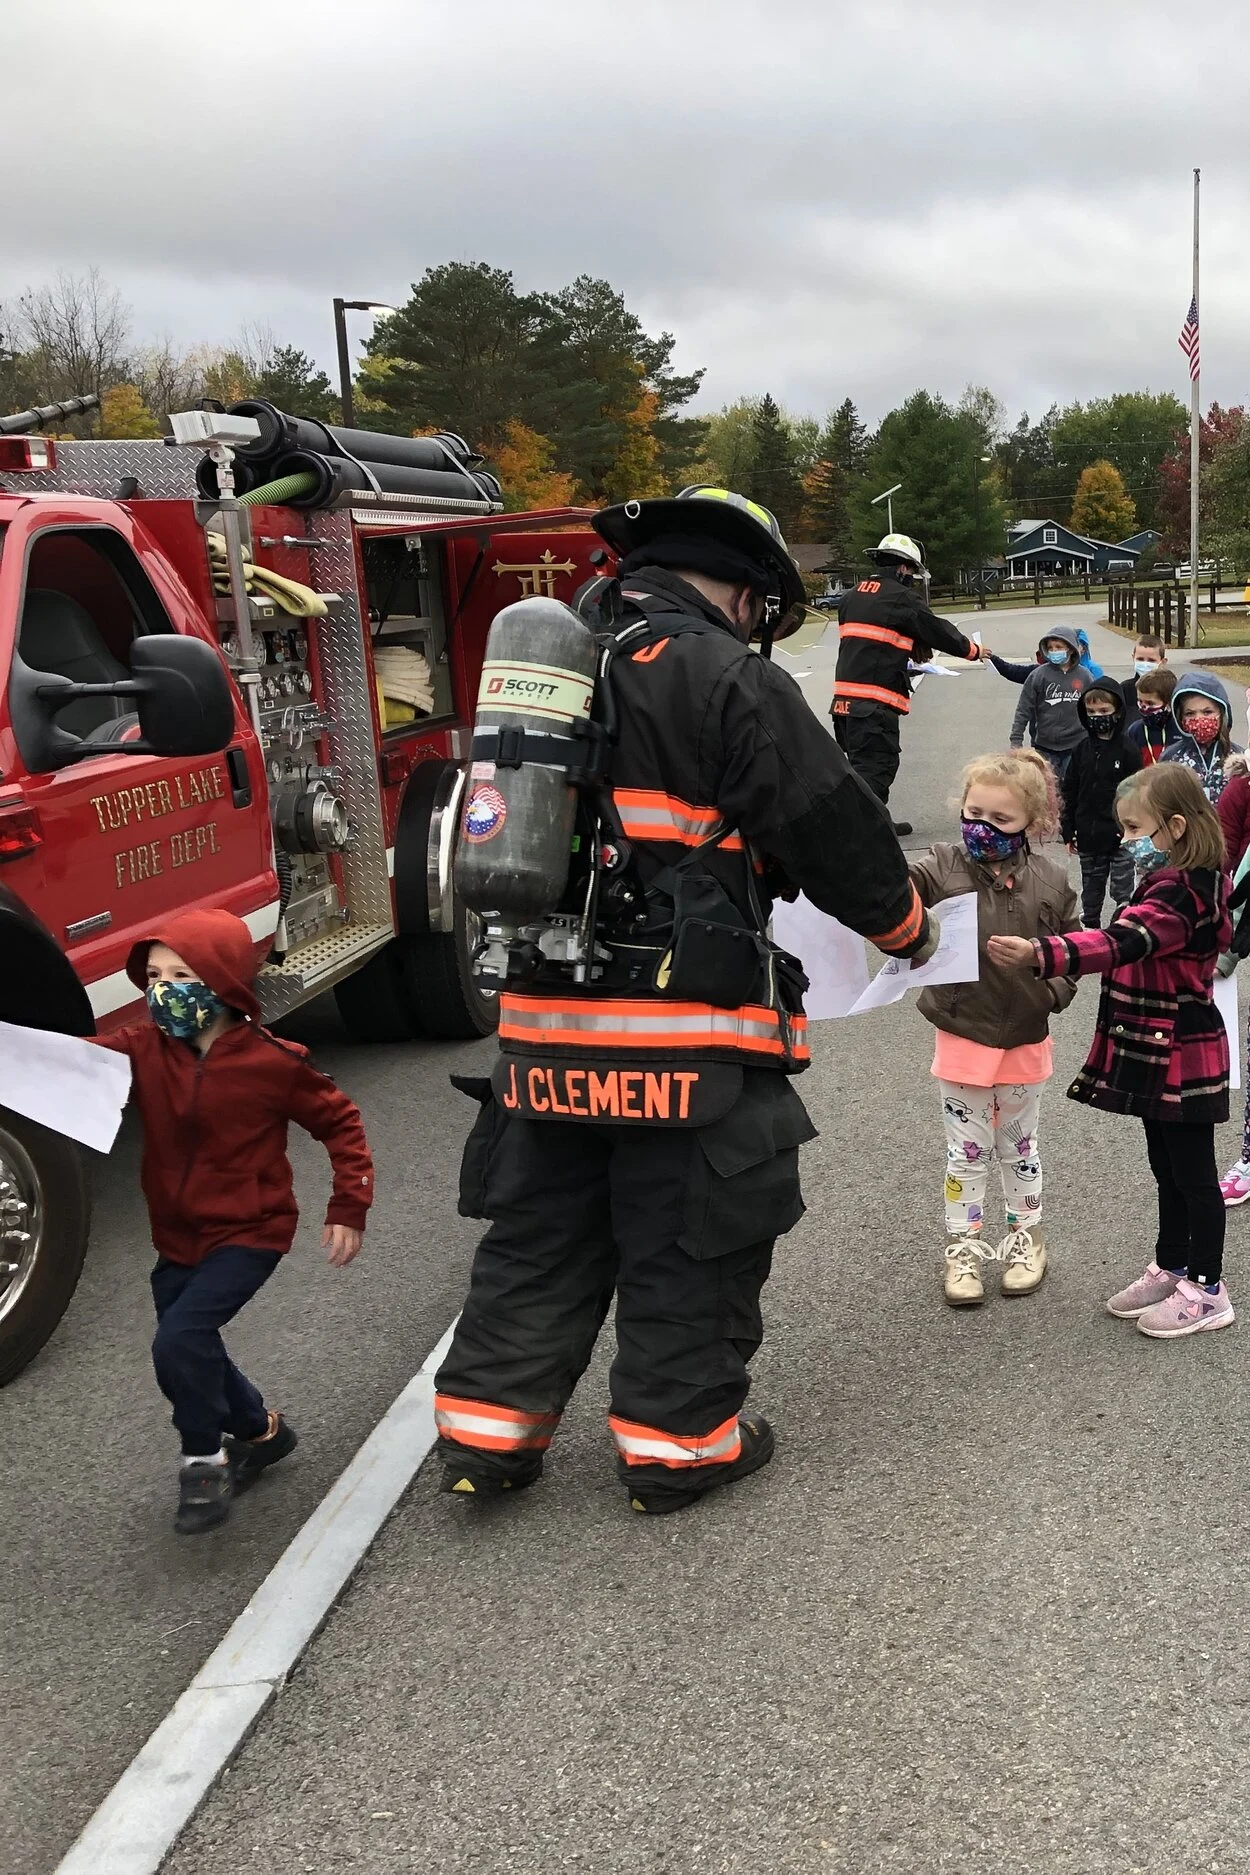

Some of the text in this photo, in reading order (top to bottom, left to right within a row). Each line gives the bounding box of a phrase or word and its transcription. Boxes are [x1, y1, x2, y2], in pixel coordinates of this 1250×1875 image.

[857, 581, 881, 593] TLFD
[505, 679, 559, 696] SCOTT
[90, 766, 225, 832] TUPPER LAKE
[114, 822, 221, 888] FIRE DEPT.
[504, 1064, 699, 1119] J. CLEMENT
